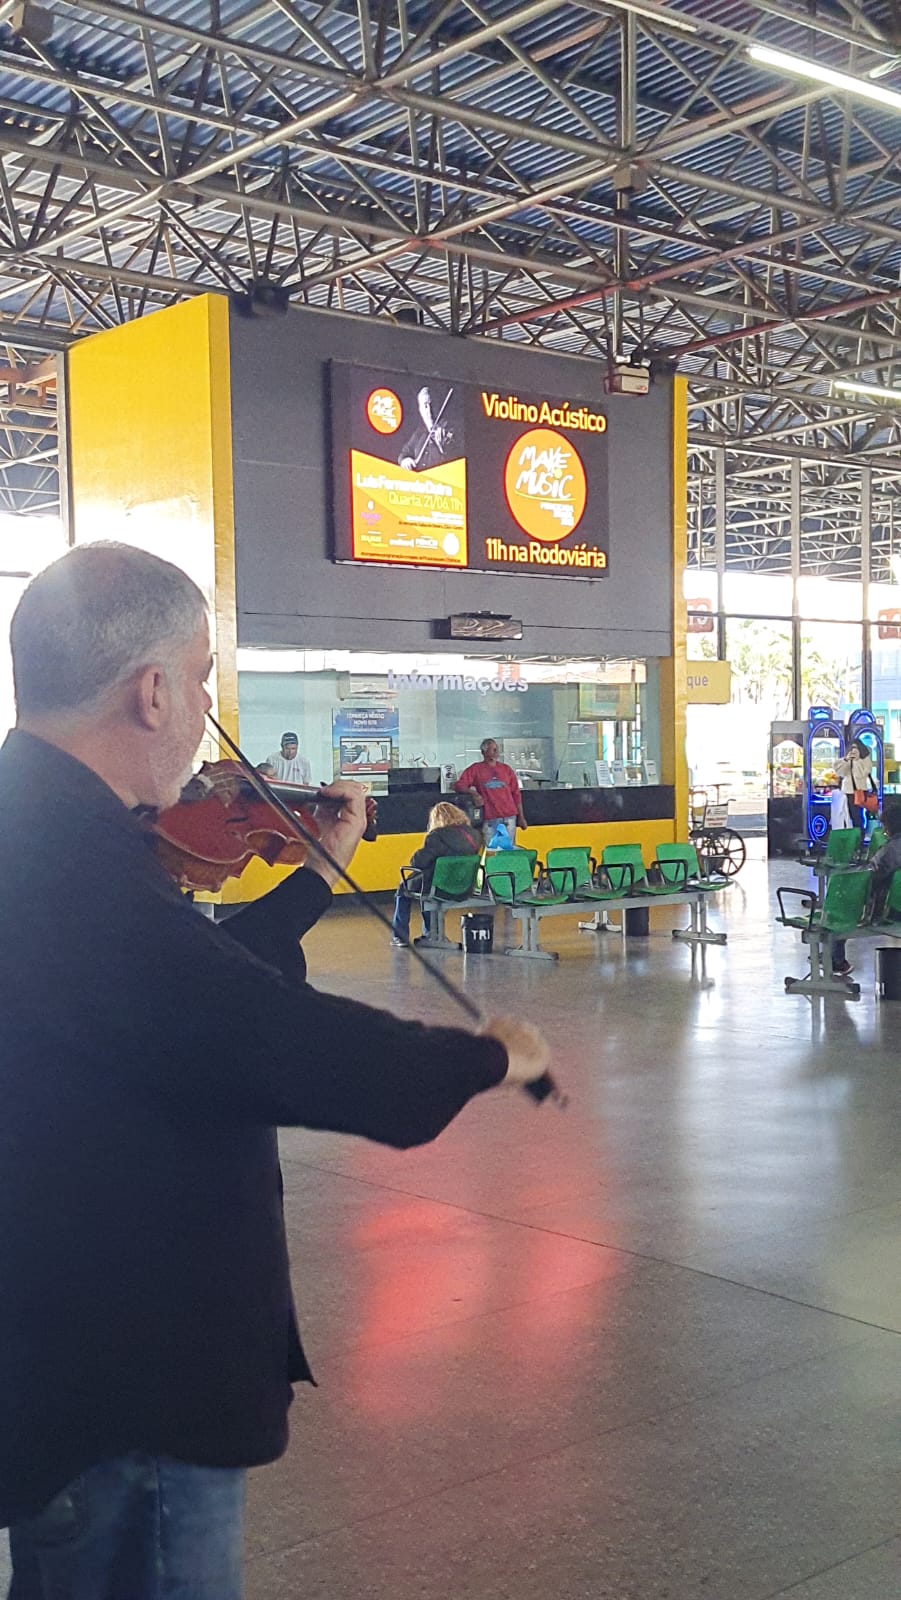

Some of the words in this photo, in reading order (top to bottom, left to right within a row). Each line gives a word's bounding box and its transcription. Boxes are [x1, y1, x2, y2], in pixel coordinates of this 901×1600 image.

[481, 391, 539, 422] Violino
[538, 401, 607, 432] Acústico
[518, 445, 572, 472] MAKE
[515, 470, 574, 498] MUSIC
[486, 538, 508, 561] 11h
[508, 544, 528, 562] na
[528, 541, 607, 568] Rodoviária
[388, 669, 529, 695] Informações
[687, 675, 708, 687] que
[471, 929, 490, 940] TRI
